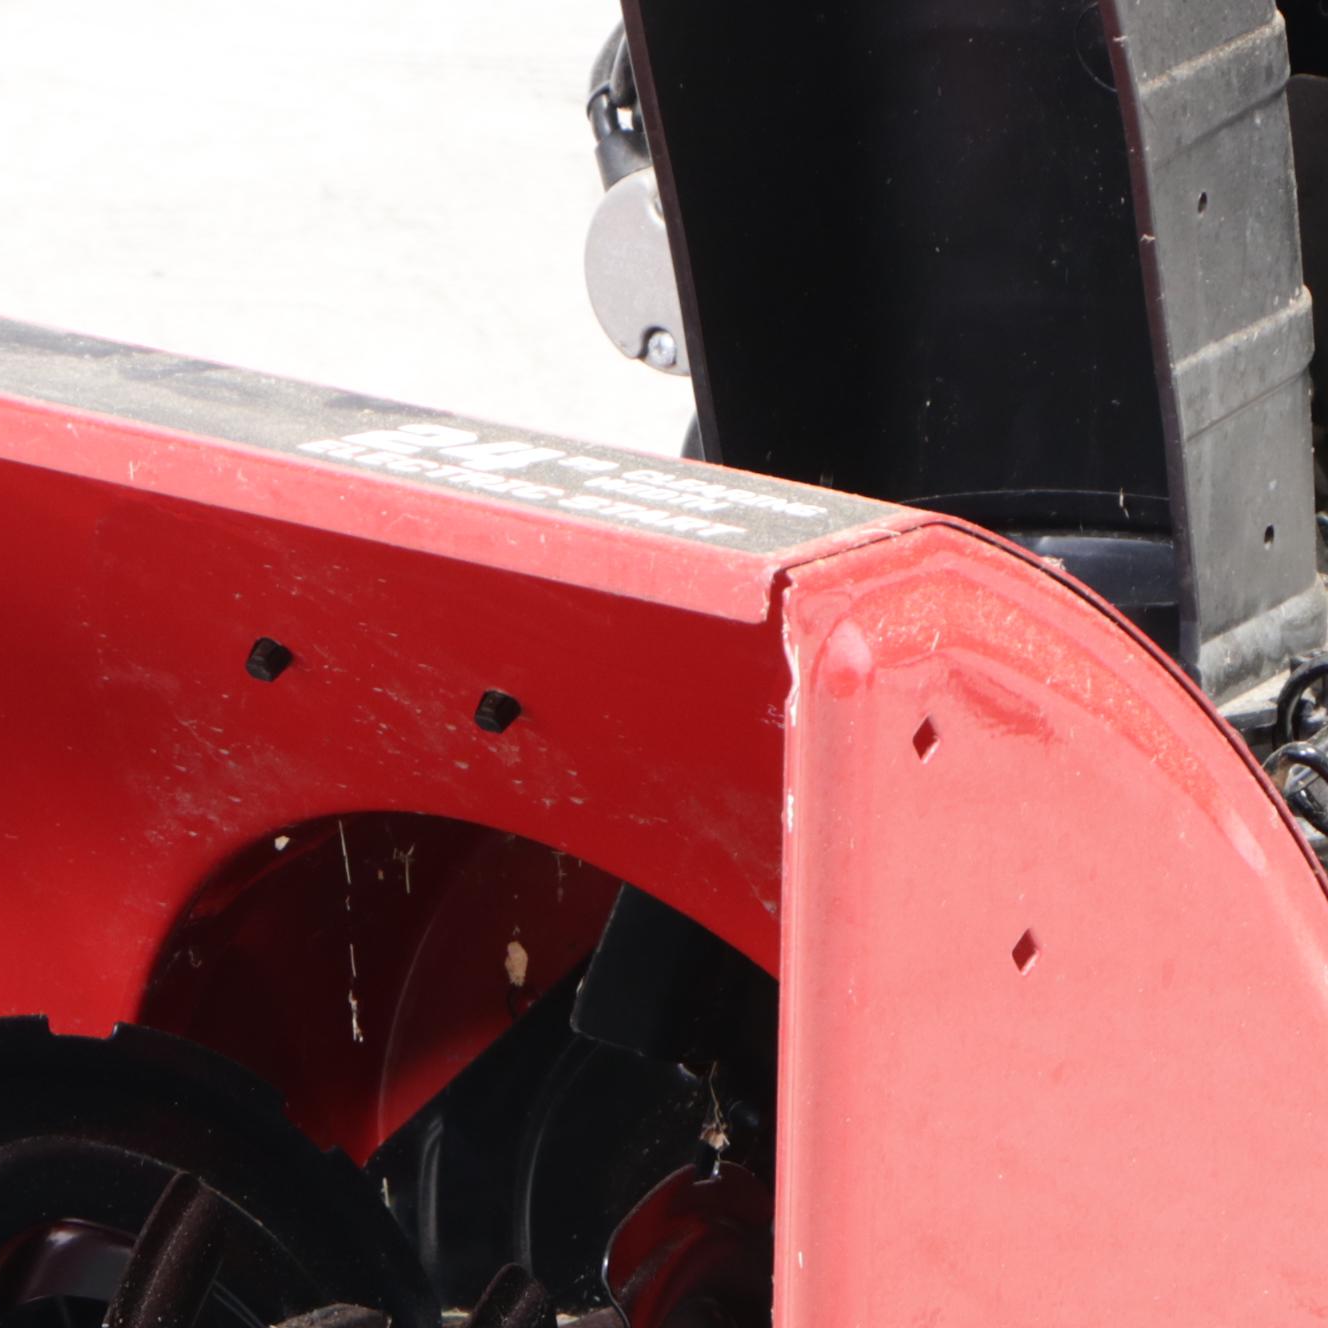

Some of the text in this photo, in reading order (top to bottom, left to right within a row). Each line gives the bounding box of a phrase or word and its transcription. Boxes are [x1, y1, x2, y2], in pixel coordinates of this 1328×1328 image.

[340, 423, 566, 471] 24
[297, 439, 748, 537] ELECTRIC START
[622, 468, 828, 517] CLEARING
